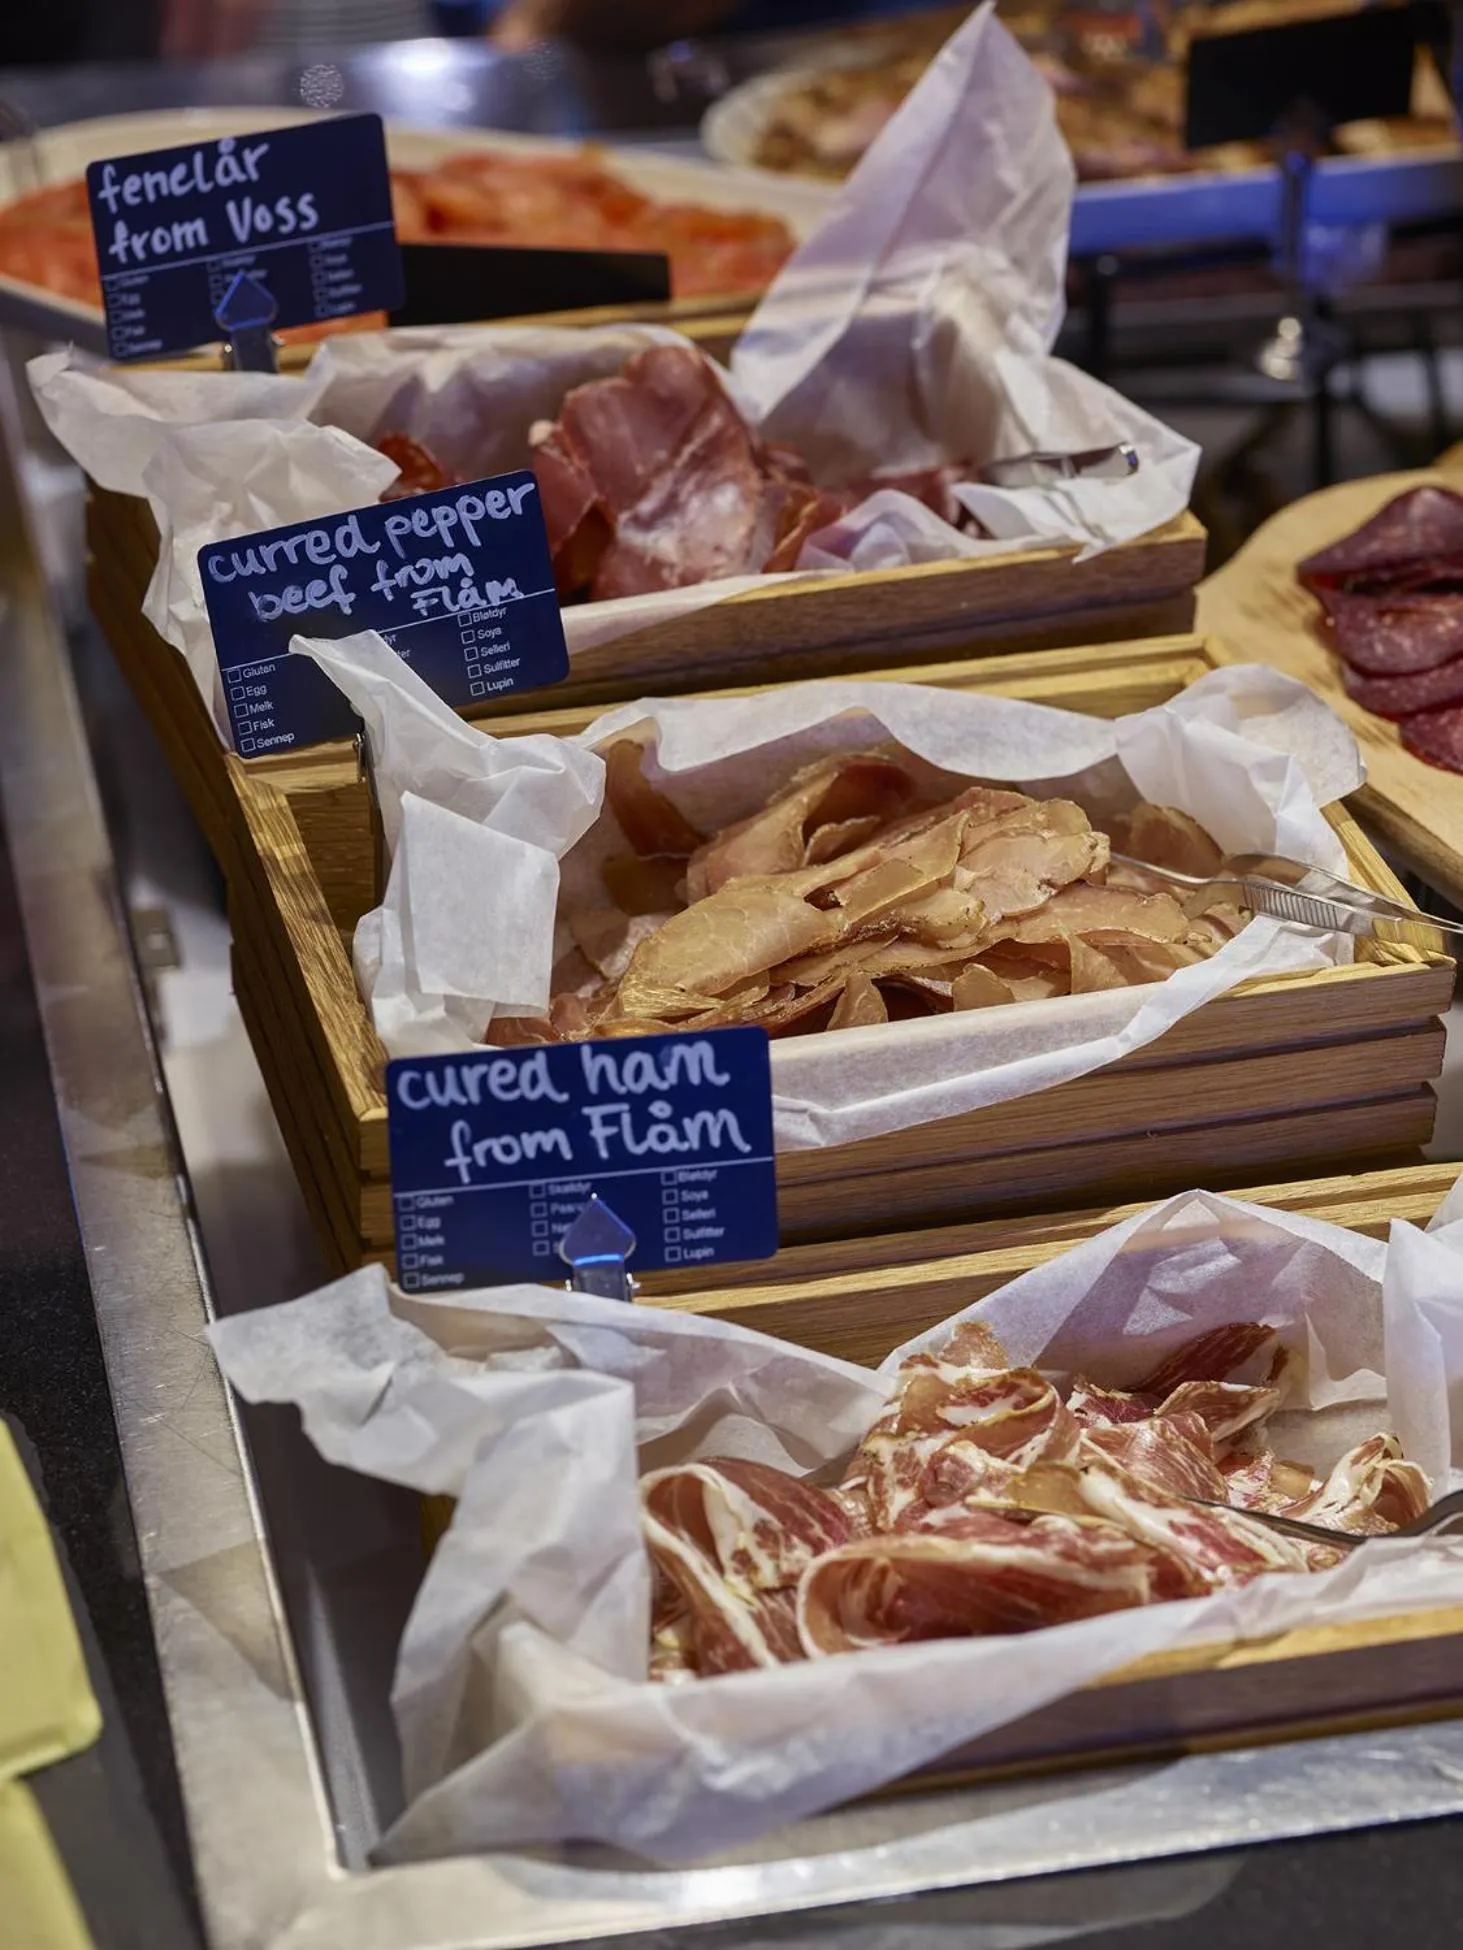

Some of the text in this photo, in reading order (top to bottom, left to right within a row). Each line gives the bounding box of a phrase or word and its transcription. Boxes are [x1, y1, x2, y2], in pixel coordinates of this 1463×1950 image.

[99, 137, 269, 213] fenelår
[108, 193, 319, 264] from Voss
[208, 482, 535, 583] curred pepper
[249, 553, 473, 622] beef from
[473, 606, 507, 623] Bløtdyr
[477, 626, 502, 641] Soya
[480, 640, 510, 657] Selleri
[242, 663, 276, 678] Gluten
[483, 657, 520, 674] Sulfitter
[246, 684, 267, 698] Egg
[486, 676, 514, 692] Lupin
[249, 700, 274, 714] Melk
[253, 718, 275, 731] Fisk
[256, 732, 295, 749] Sennep
[397, 1040, 730, 1110] cured ham
[444, 1099, 752, 1184] from Flåm
[418, 1215, 441, 1230] Egg
[683, 1247, 715, 1260] Lupin
